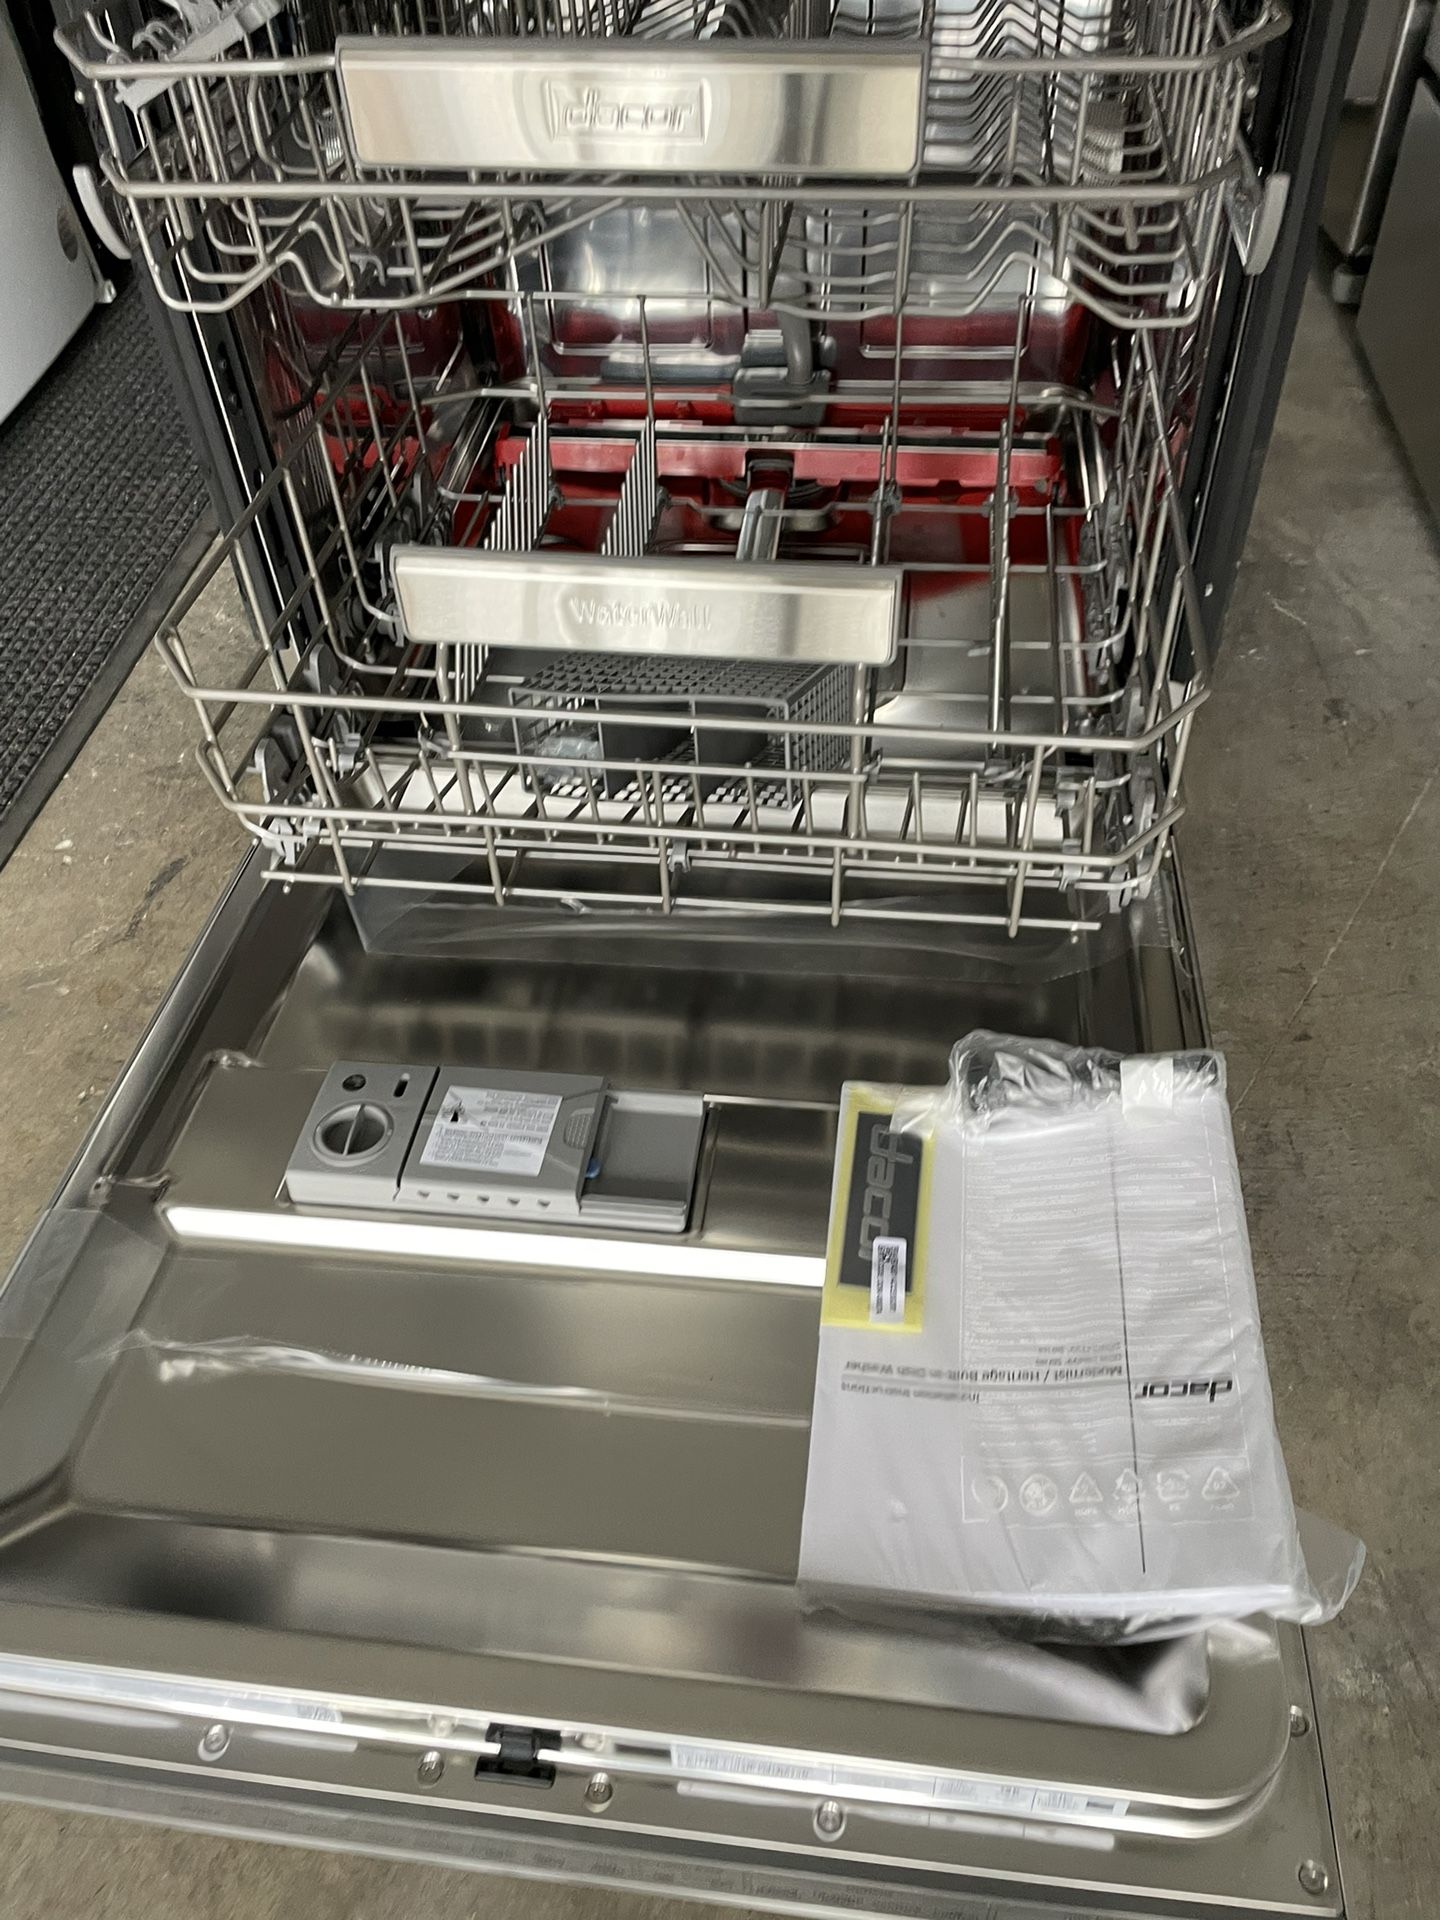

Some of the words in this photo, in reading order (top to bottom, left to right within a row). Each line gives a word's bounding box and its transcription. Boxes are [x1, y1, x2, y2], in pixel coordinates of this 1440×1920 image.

[563, 86, 695, 133] dacor
[569, 597, 713, 631] WaterWall
[981, 1368, 1040, 1383] Heritage
[1134, 1379, 1233, 1403] dacor
